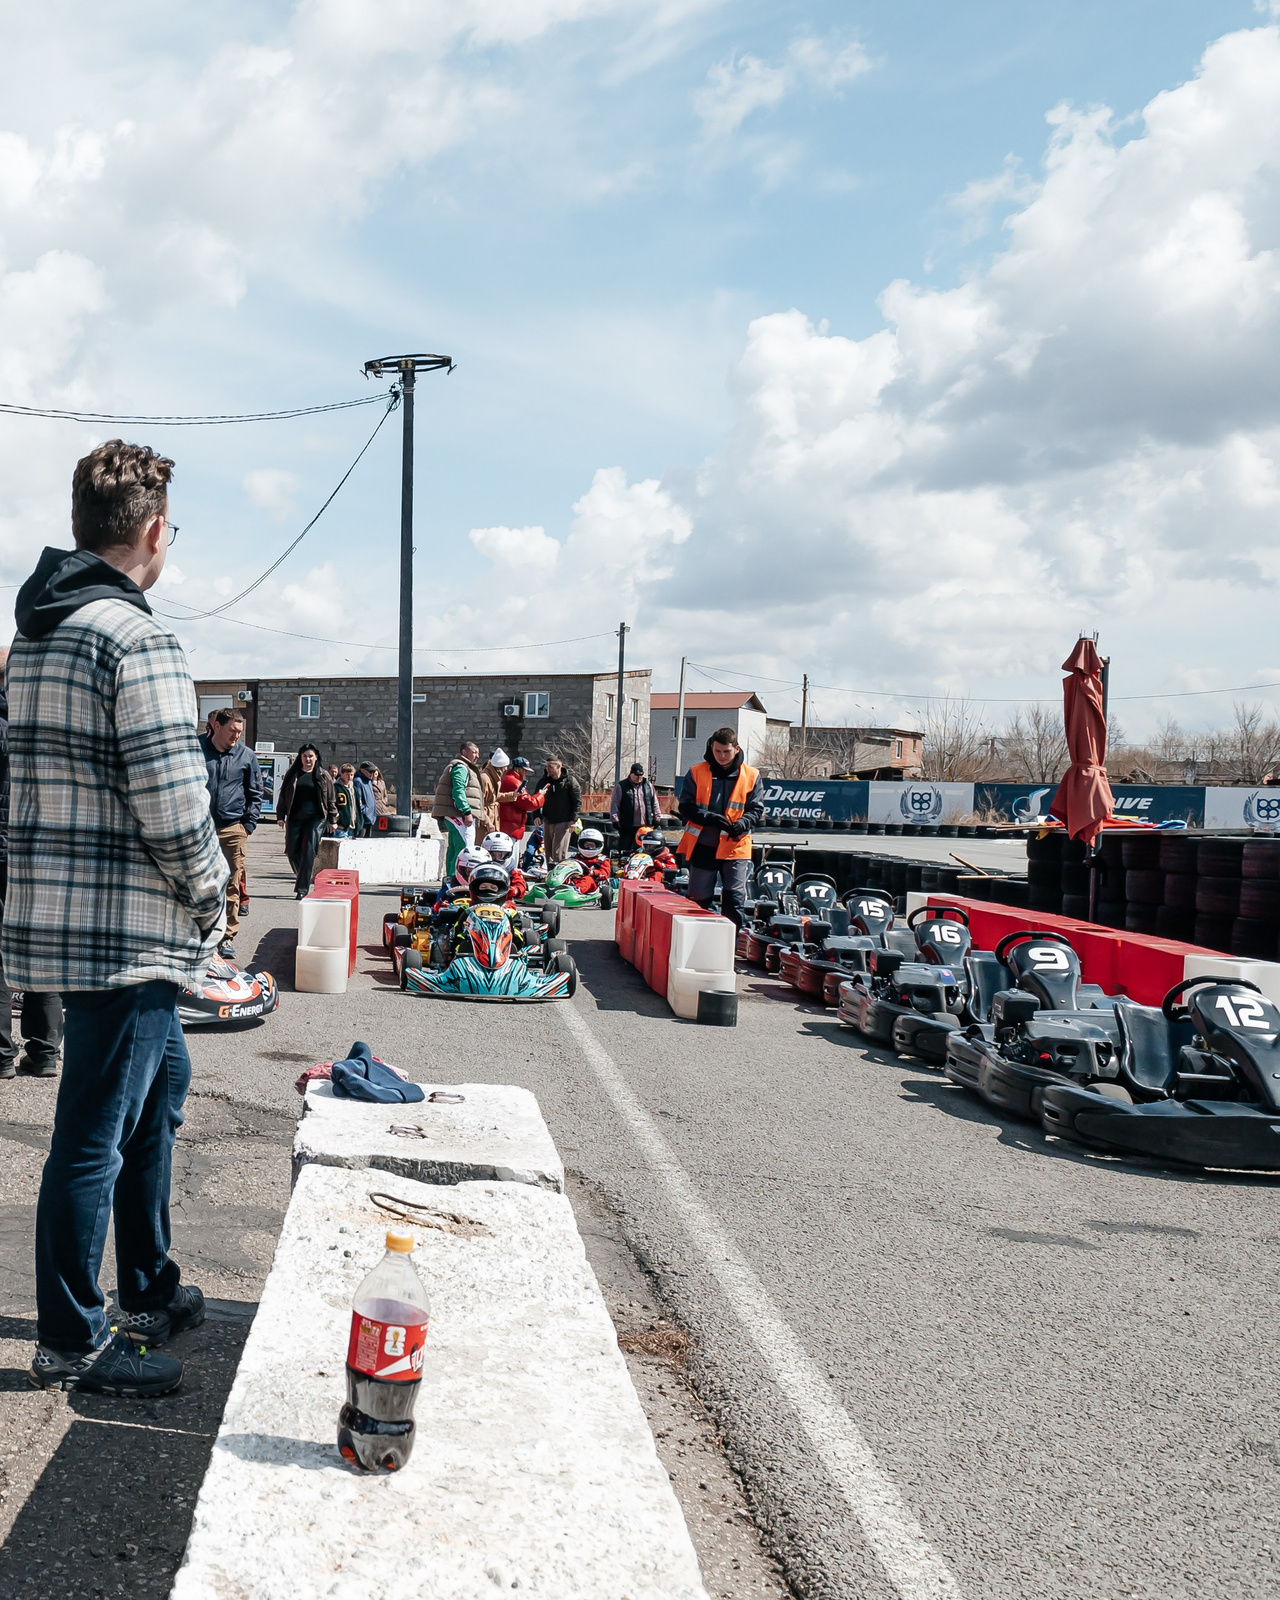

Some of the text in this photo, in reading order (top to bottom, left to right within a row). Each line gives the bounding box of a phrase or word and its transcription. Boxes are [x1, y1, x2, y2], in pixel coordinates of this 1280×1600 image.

[1113, 797, 1153, 809] IVE
[772, 807, 822, 819] RACING
[763, 872, 784, 884] 11
[804, 885, 829, 898] 17
[858, 900, 885, 918] 15
[929, 924, 961, 944] 16
[1028, 947, 1070, 971] 9
[1215, 995, 1270, 1029] 12
